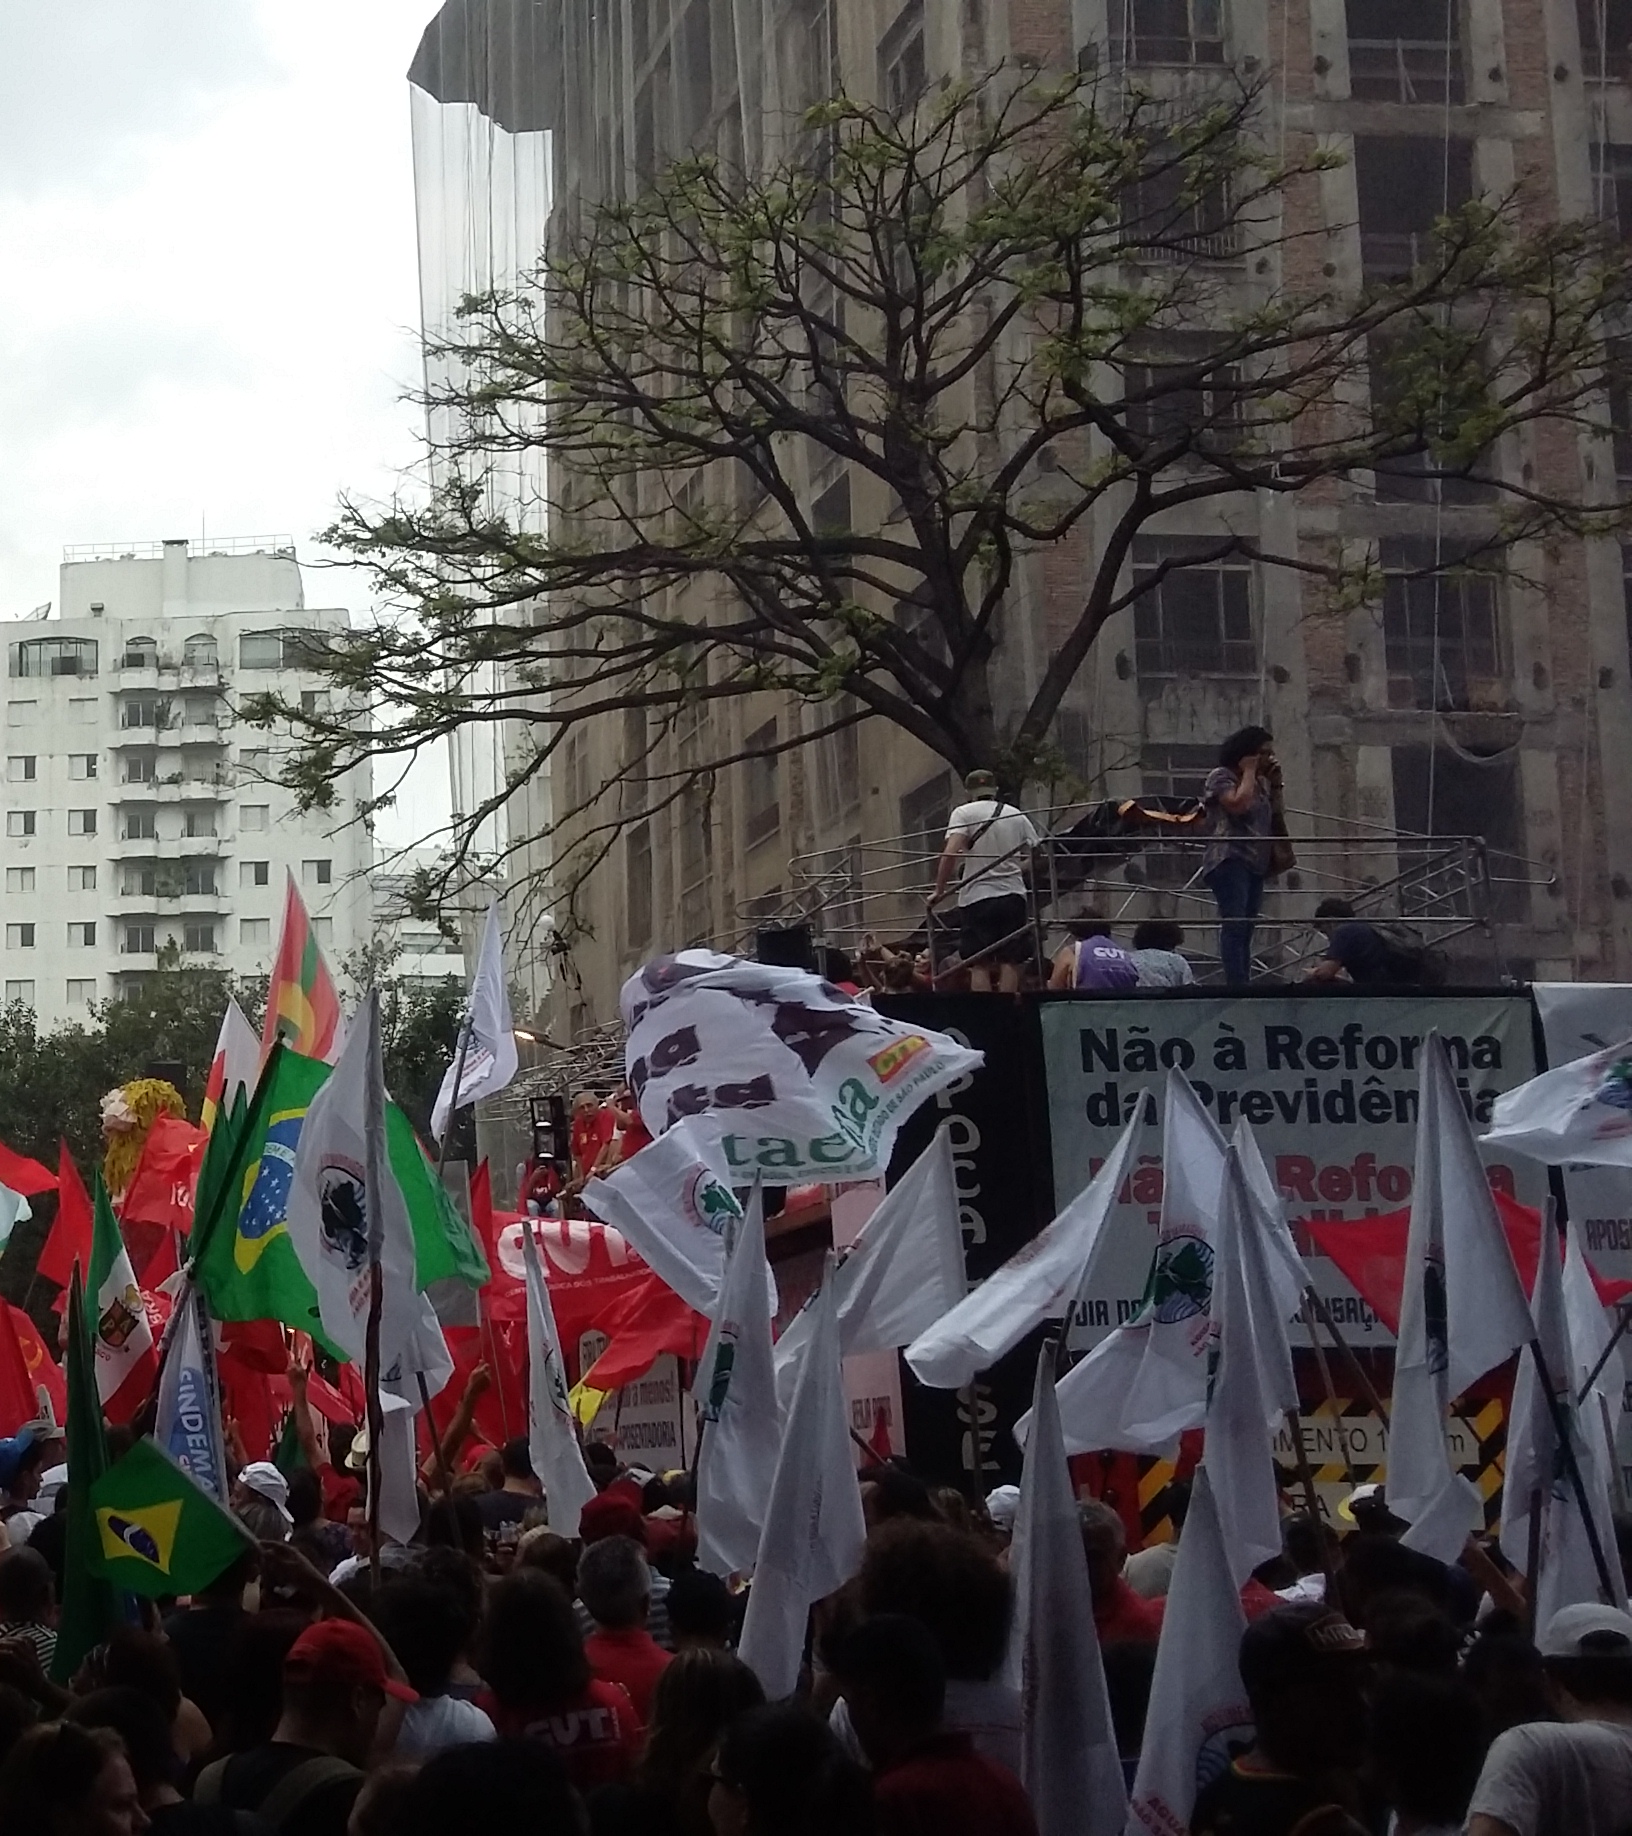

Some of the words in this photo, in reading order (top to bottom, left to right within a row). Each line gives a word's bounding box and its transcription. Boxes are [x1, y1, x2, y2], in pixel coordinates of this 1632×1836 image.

[1093, 946, 1126, 959] CUT
[1079, 1025, 1196, 1073] Não
[1213, 1022, 1248, 1072] à
[1086, 1081, 1159, 1127] da
[1188, 1075, 1496, 1126] Previdênia
[1275, 1152, 1515, 1203] Refoa
[497, 1218, 629, 1281] CUT
[1585, 1218, 1632, 1251] APOS
[176, 1369, 215, 1492] SINDEMA
[1272, 1427, 1368, 1453] IMENTO
[524, 1707, 612, 1742] CUT
